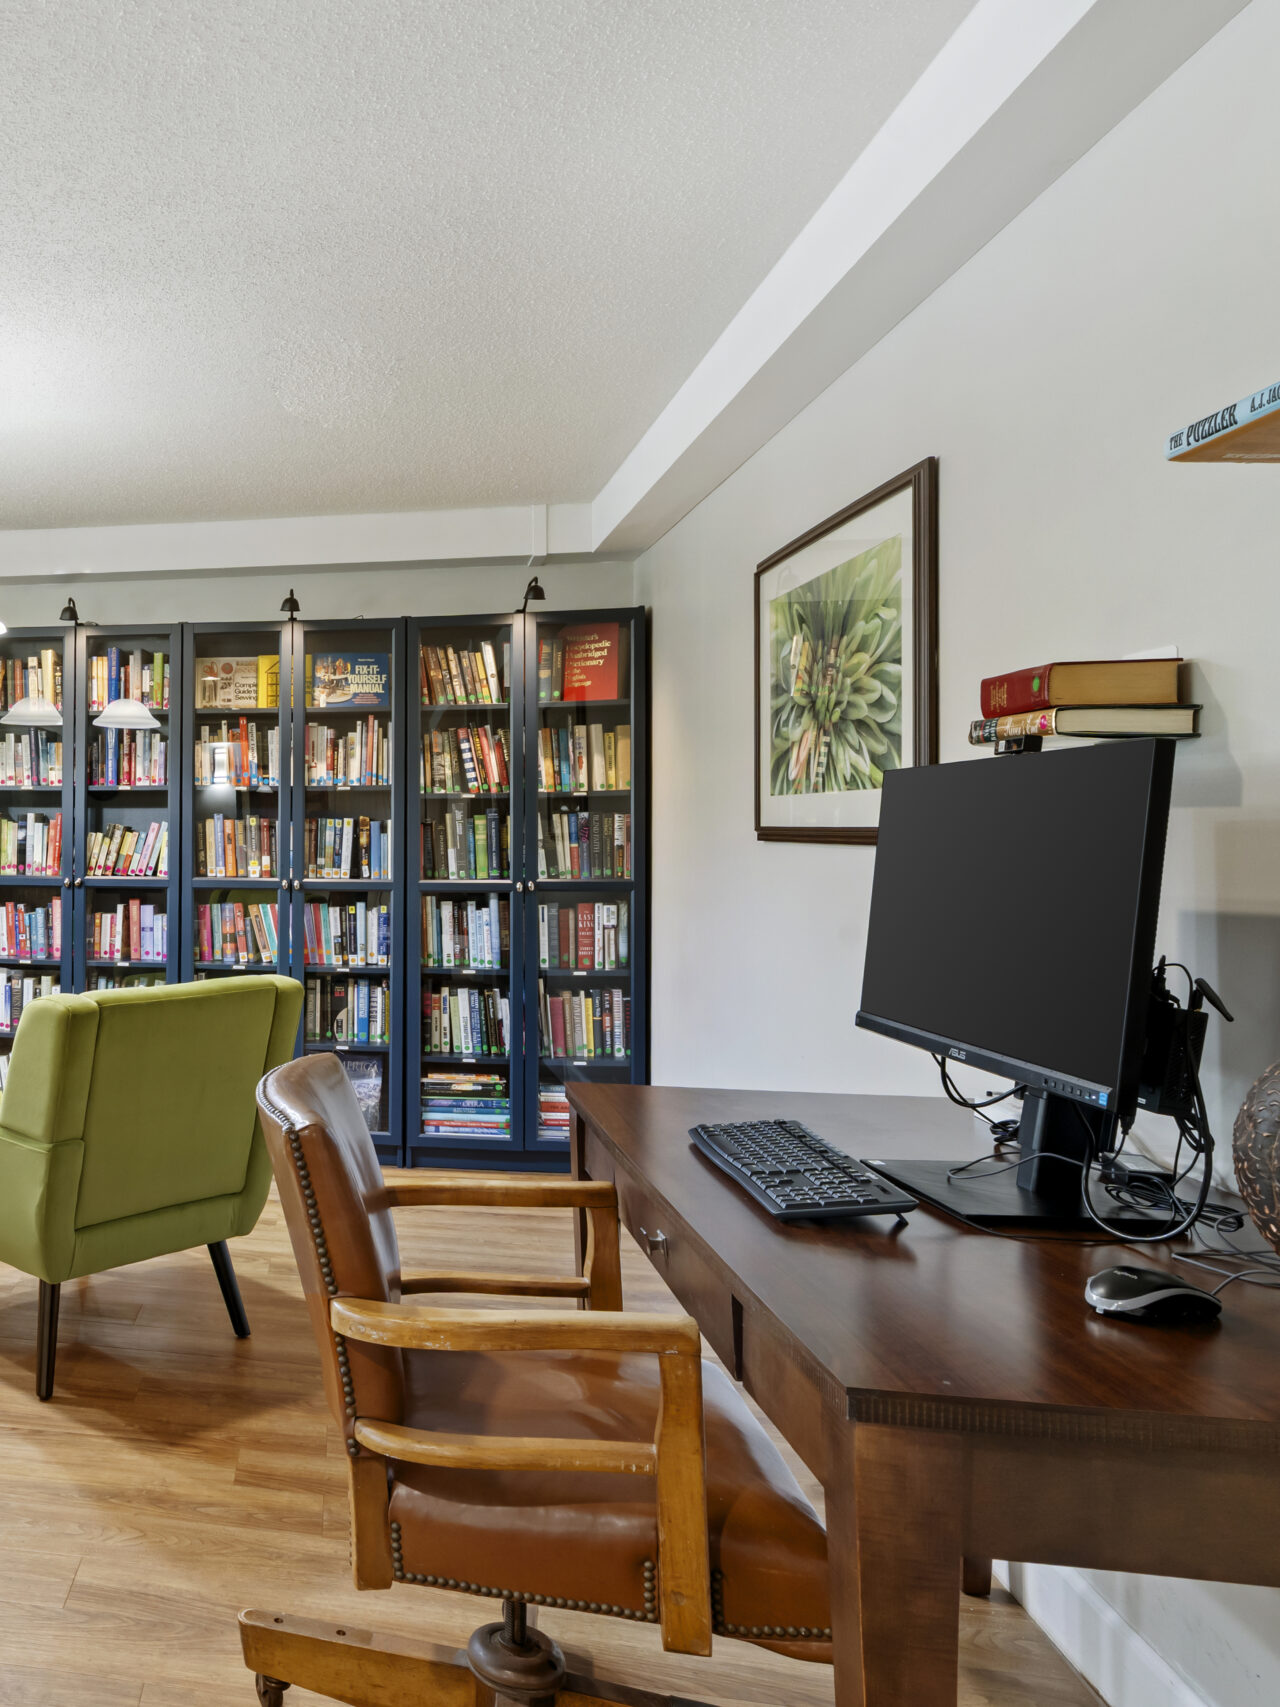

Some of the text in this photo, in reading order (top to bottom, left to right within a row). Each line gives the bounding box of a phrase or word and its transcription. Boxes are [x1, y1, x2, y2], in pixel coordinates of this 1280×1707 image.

[1169, 403, 1238, 450] THE PUZZLER
[565, 649, 608, 659] nabridged
[348, 674, 387, 684] YOURSELF
[350, 683, 385, 694] MANUAL
[581, 827, 590, 843] 1776
[592, 814, 600, 853] BLIND FAITH
[948, 1047, 967, 1060] ASUS
